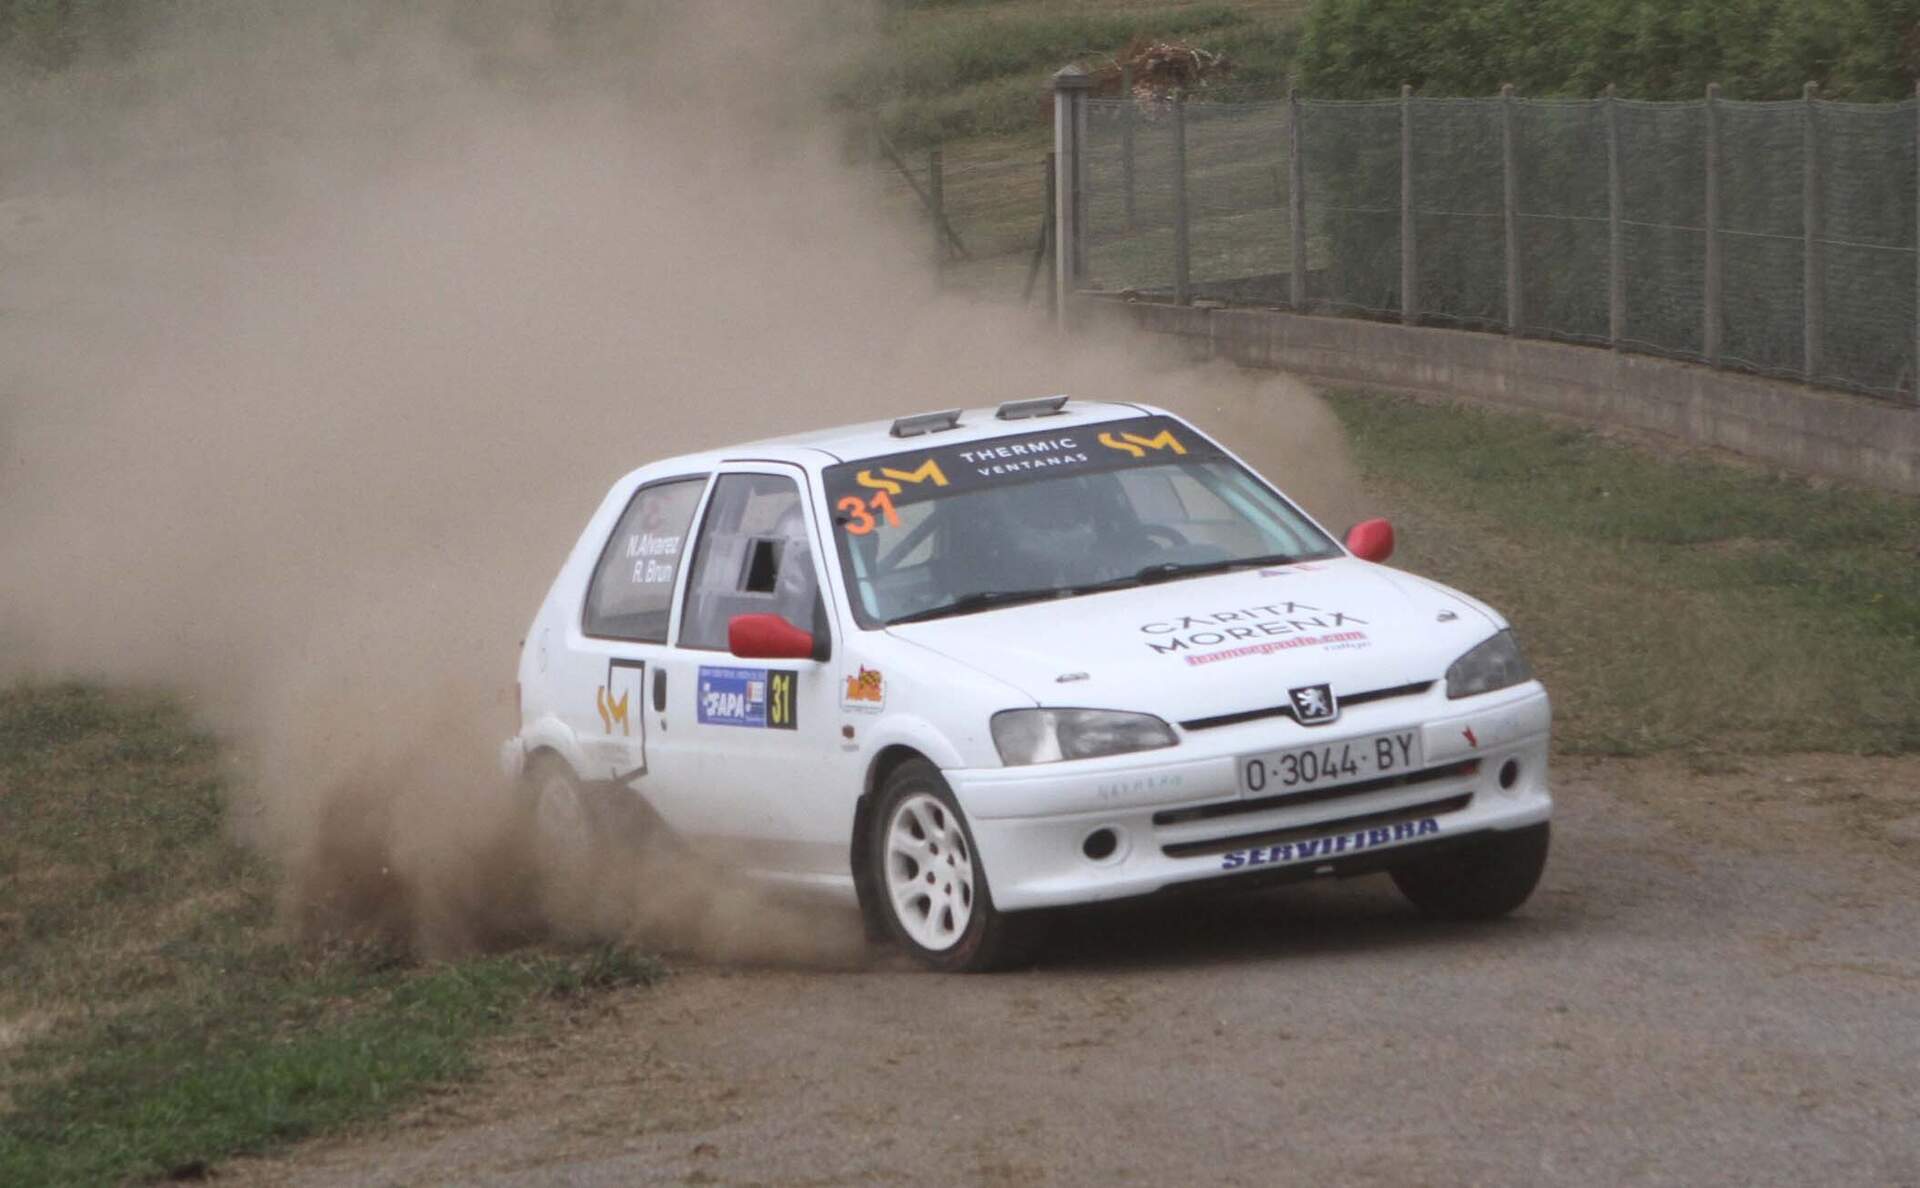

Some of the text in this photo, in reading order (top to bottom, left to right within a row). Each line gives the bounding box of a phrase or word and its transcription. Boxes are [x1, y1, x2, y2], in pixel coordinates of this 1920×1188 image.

[960, 437, 1077, 465] THERMIC
[977, 453, 1088, 477] VENTANAS
[836, 489, 900, 536] 31
[1140, 600, 1321, 635] CARITA
[1145, 611, 1370, 655] MORENA
[771, 674, 790, 724] 31
[1221, 817, 1440, 870] SERVIFIBRA
